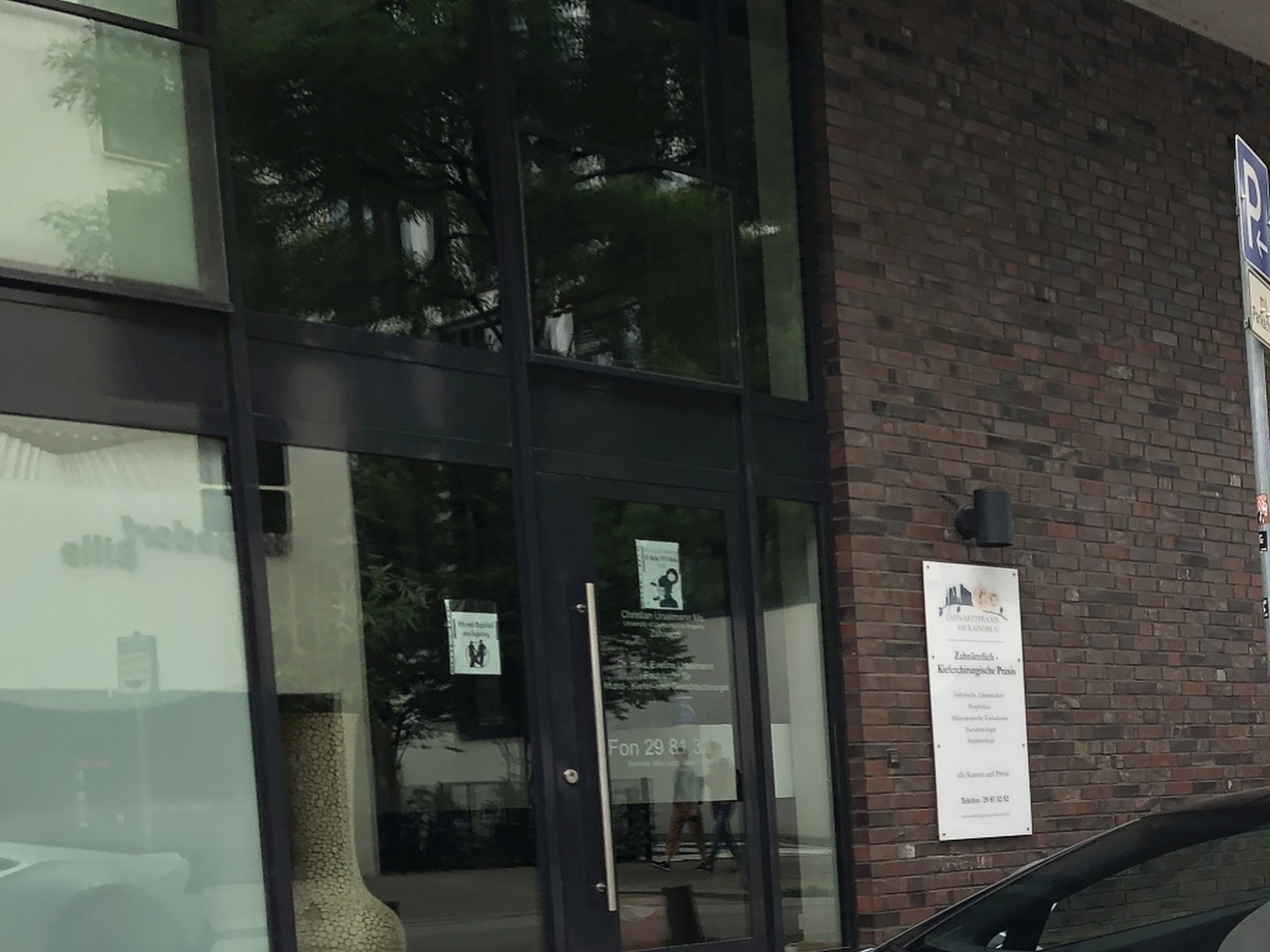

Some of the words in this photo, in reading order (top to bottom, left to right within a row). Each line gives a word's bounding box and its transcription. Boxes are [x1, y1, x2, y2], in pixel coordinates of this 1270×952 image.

[1243, 158, 1261, 250] P
[996, 666, 1016, 676] Praxis
[608, 738, 640, 756] Fon
[643, 738, 665, 756] 29
